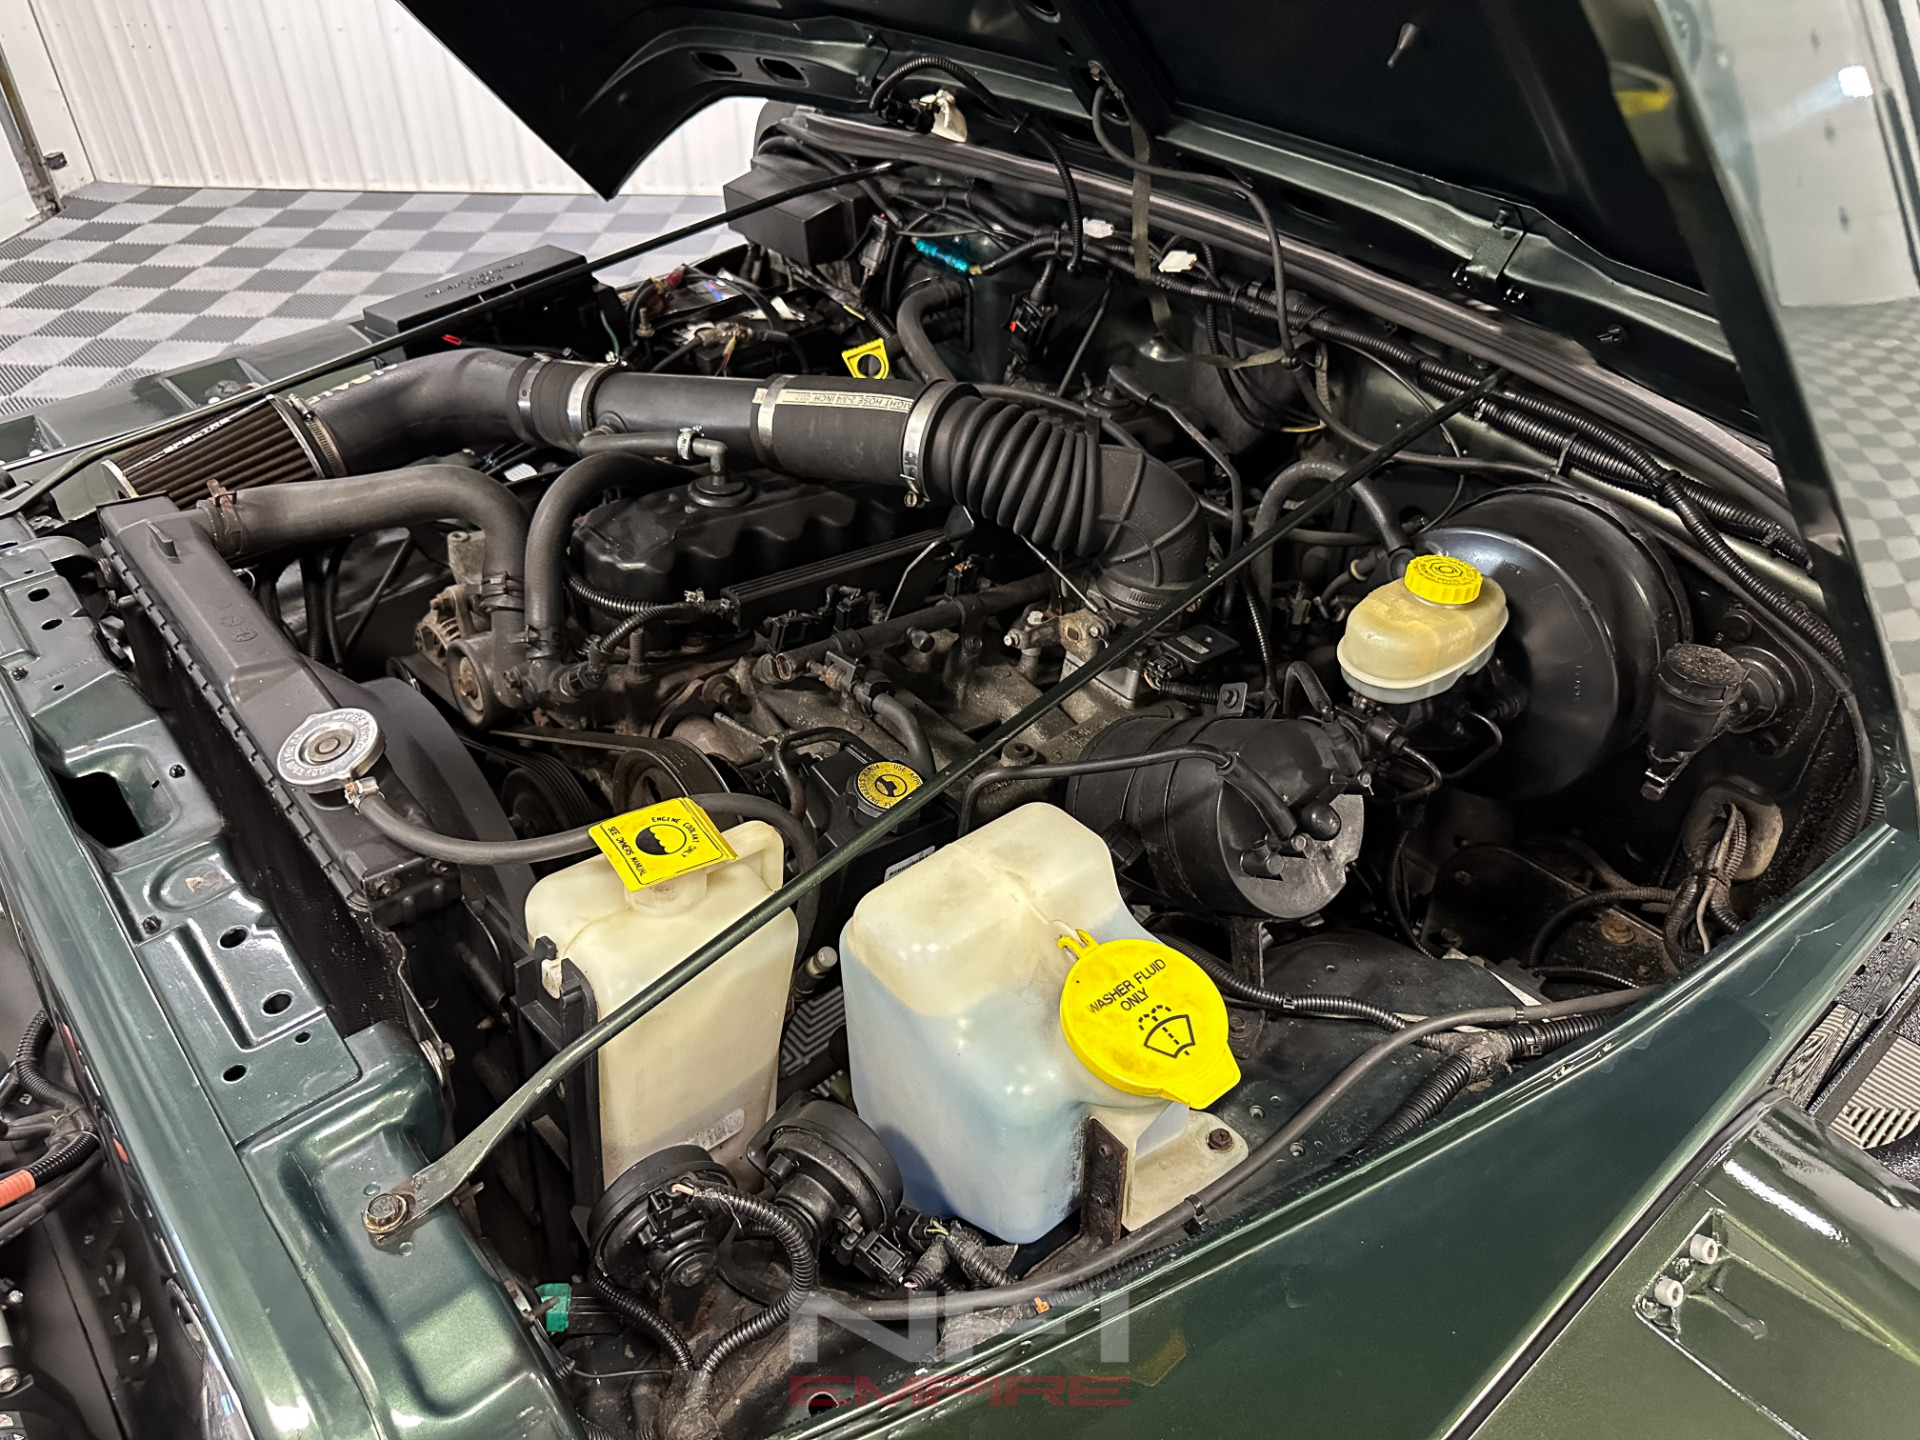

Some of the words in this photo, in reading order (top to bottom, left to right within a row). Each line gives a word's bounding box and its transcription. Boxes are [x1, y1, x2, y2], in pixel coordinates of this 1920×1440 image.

[814, 395, 835, 403] INCH
[858, 398, 883, 407] HOSE
[651, 816, 682, 824] ENGINE
[683, 822, 700, 843] COOLANT
[607, 826, 621, 836] SEE
[631, 857, 647, 877] MANUAL
[681, 845, 697, 858] ONLY
[1088, 979, 1136, 1014] WASHER
[1133, 958, 1167, 985] FLUID
[1120, 987, 1150, 1012] ONLY
